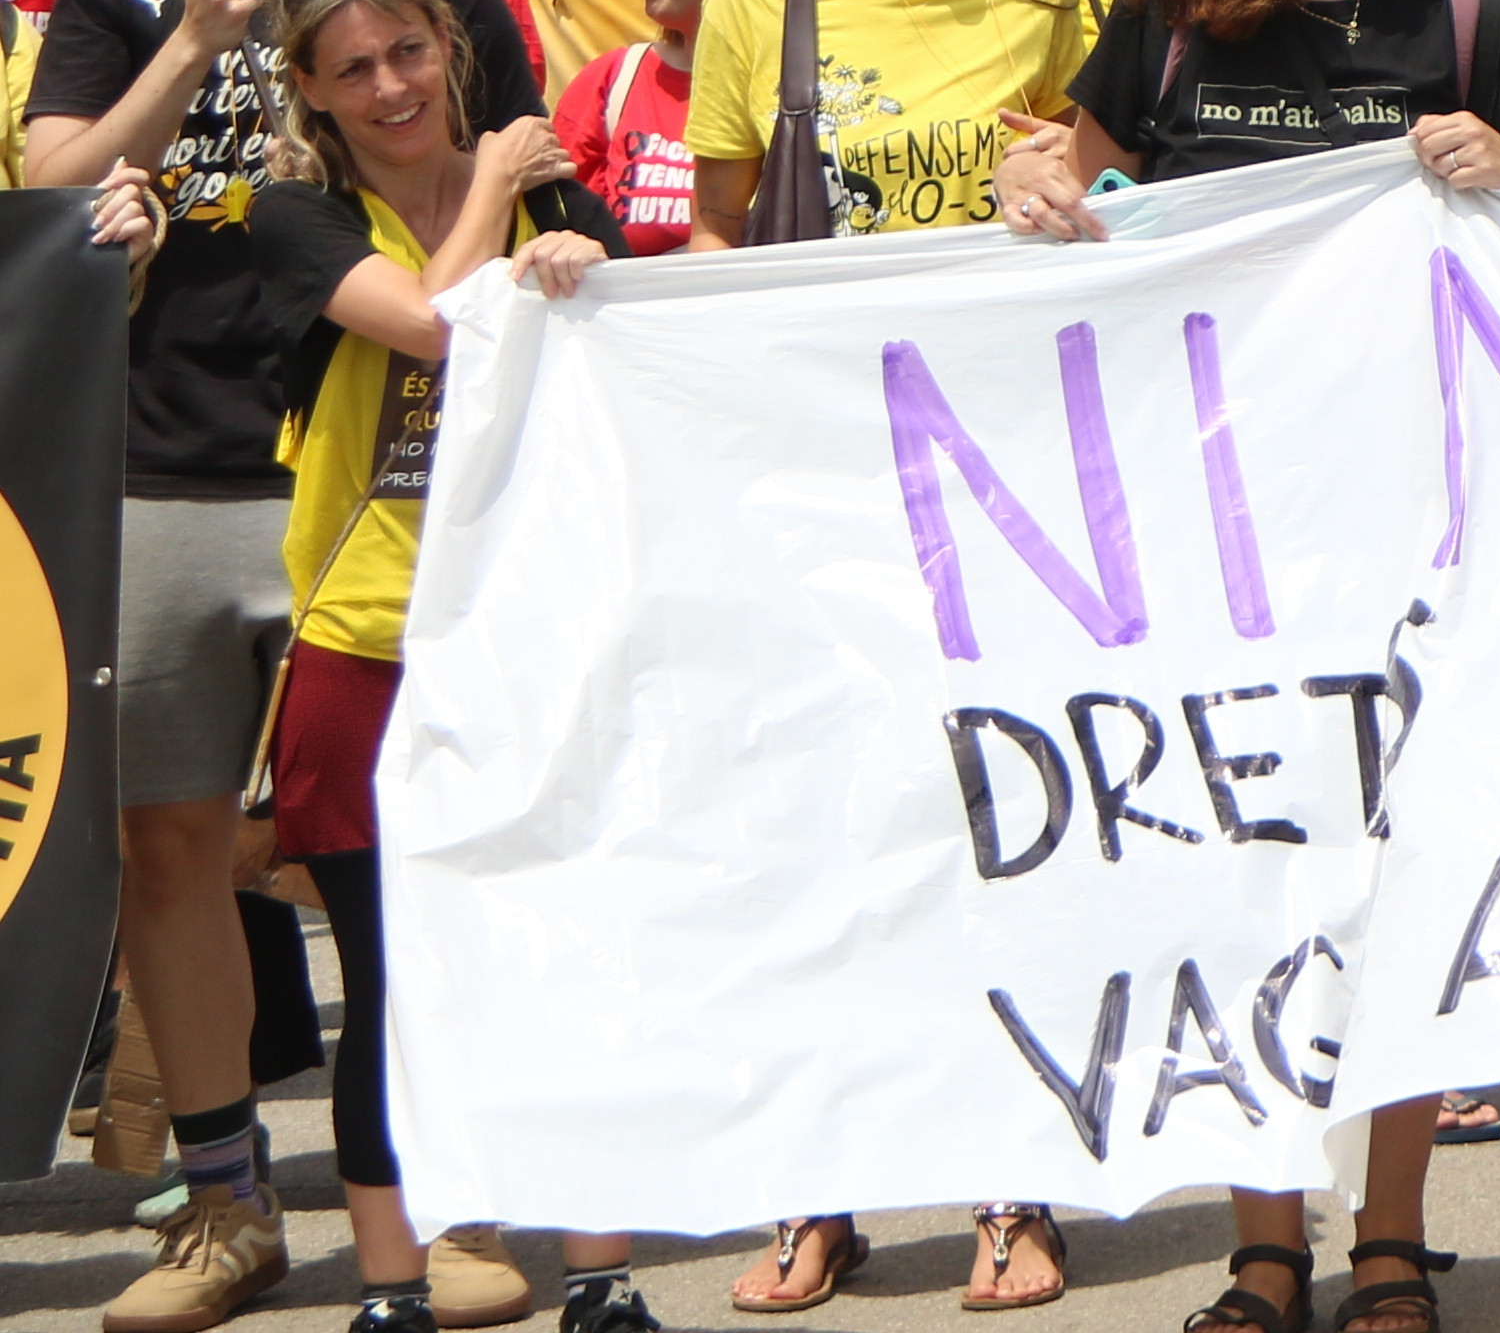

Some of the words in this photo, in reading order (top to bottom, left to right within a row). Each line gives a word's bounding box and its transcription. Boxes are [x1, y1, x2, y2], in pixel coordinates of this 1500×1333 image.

[1201, 102, 1243, 122] no
[844, 118, 994, 181] DEFENSEM
[880, 310, 1276, 662] NI
